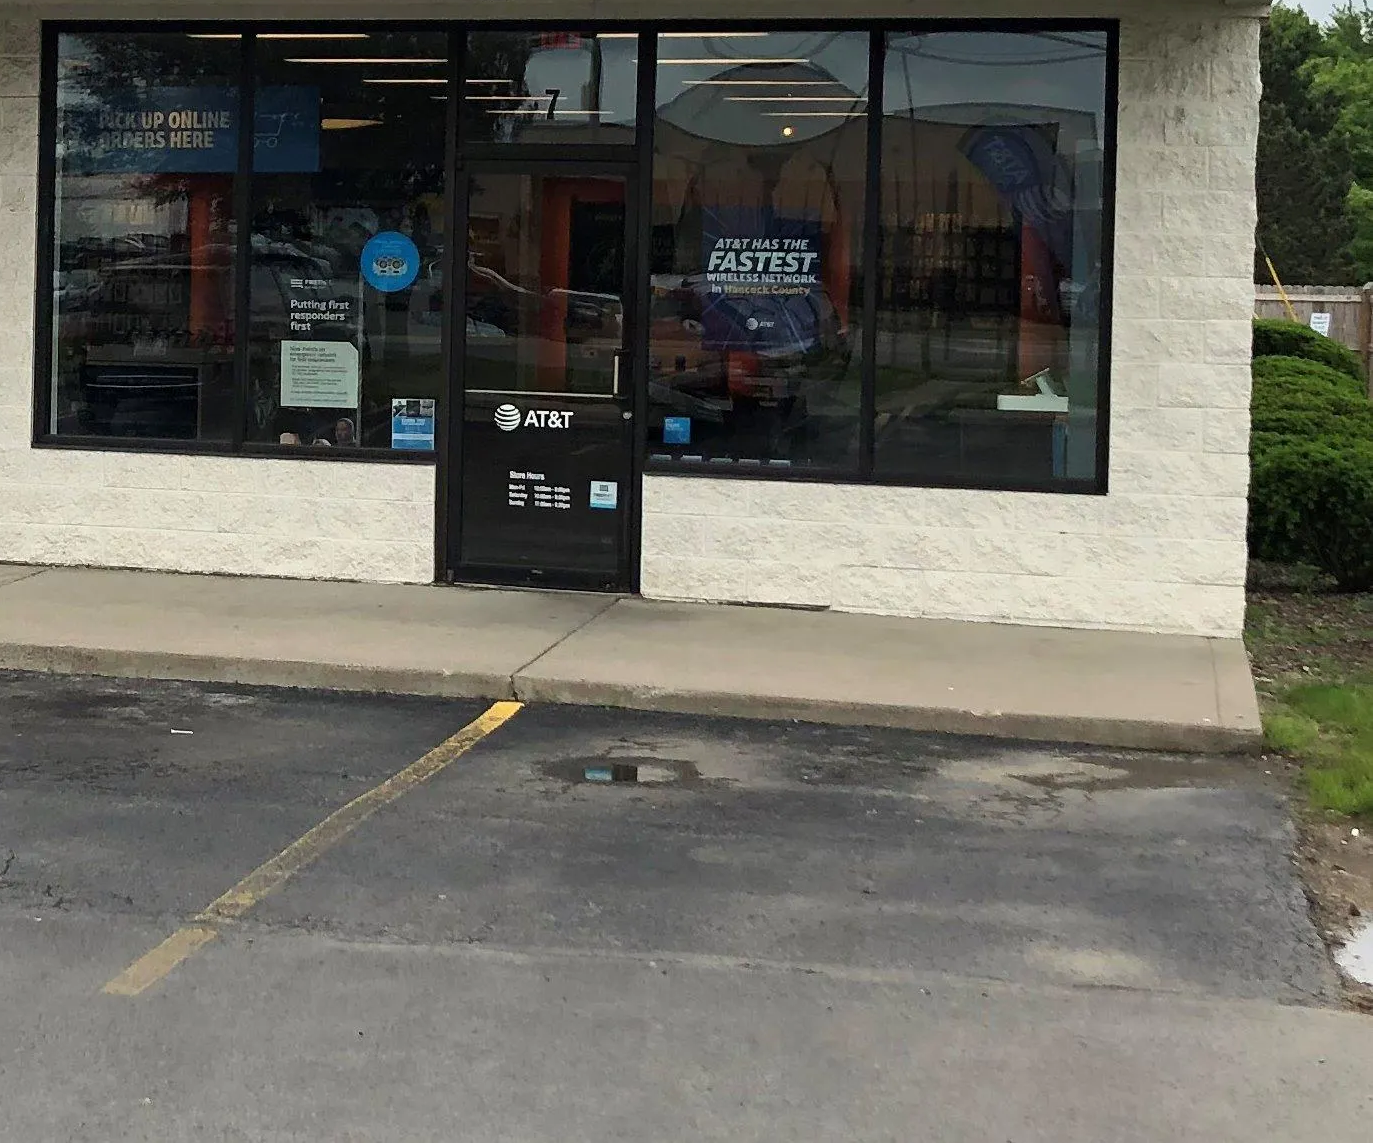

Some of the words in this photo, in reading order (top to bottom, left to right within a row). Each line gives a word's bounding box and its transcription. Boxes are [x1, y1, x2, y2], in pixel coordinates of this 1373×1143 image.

[141, 111, 165, 129] UP
[168, 110, 230, 129] ONLINE
[169, 131, 215, 149] HERE
[714, 237, 751, 250] AT&T
[751, 238, 780, 250] HAS
[782, 238, 810, 250] THE
[707, 250, 818, 273] FASTEST
[706, 272, 759, 283] WIRELESS
[761, 273, 817, 284] NETWORK
[290, 299, 327, 311] Putting
[328, 299, 350, 311] first
[290, 310, 346, 322] responders
[290, 321, 311, 331] first
[523, 409, 574, 429] AT&T
